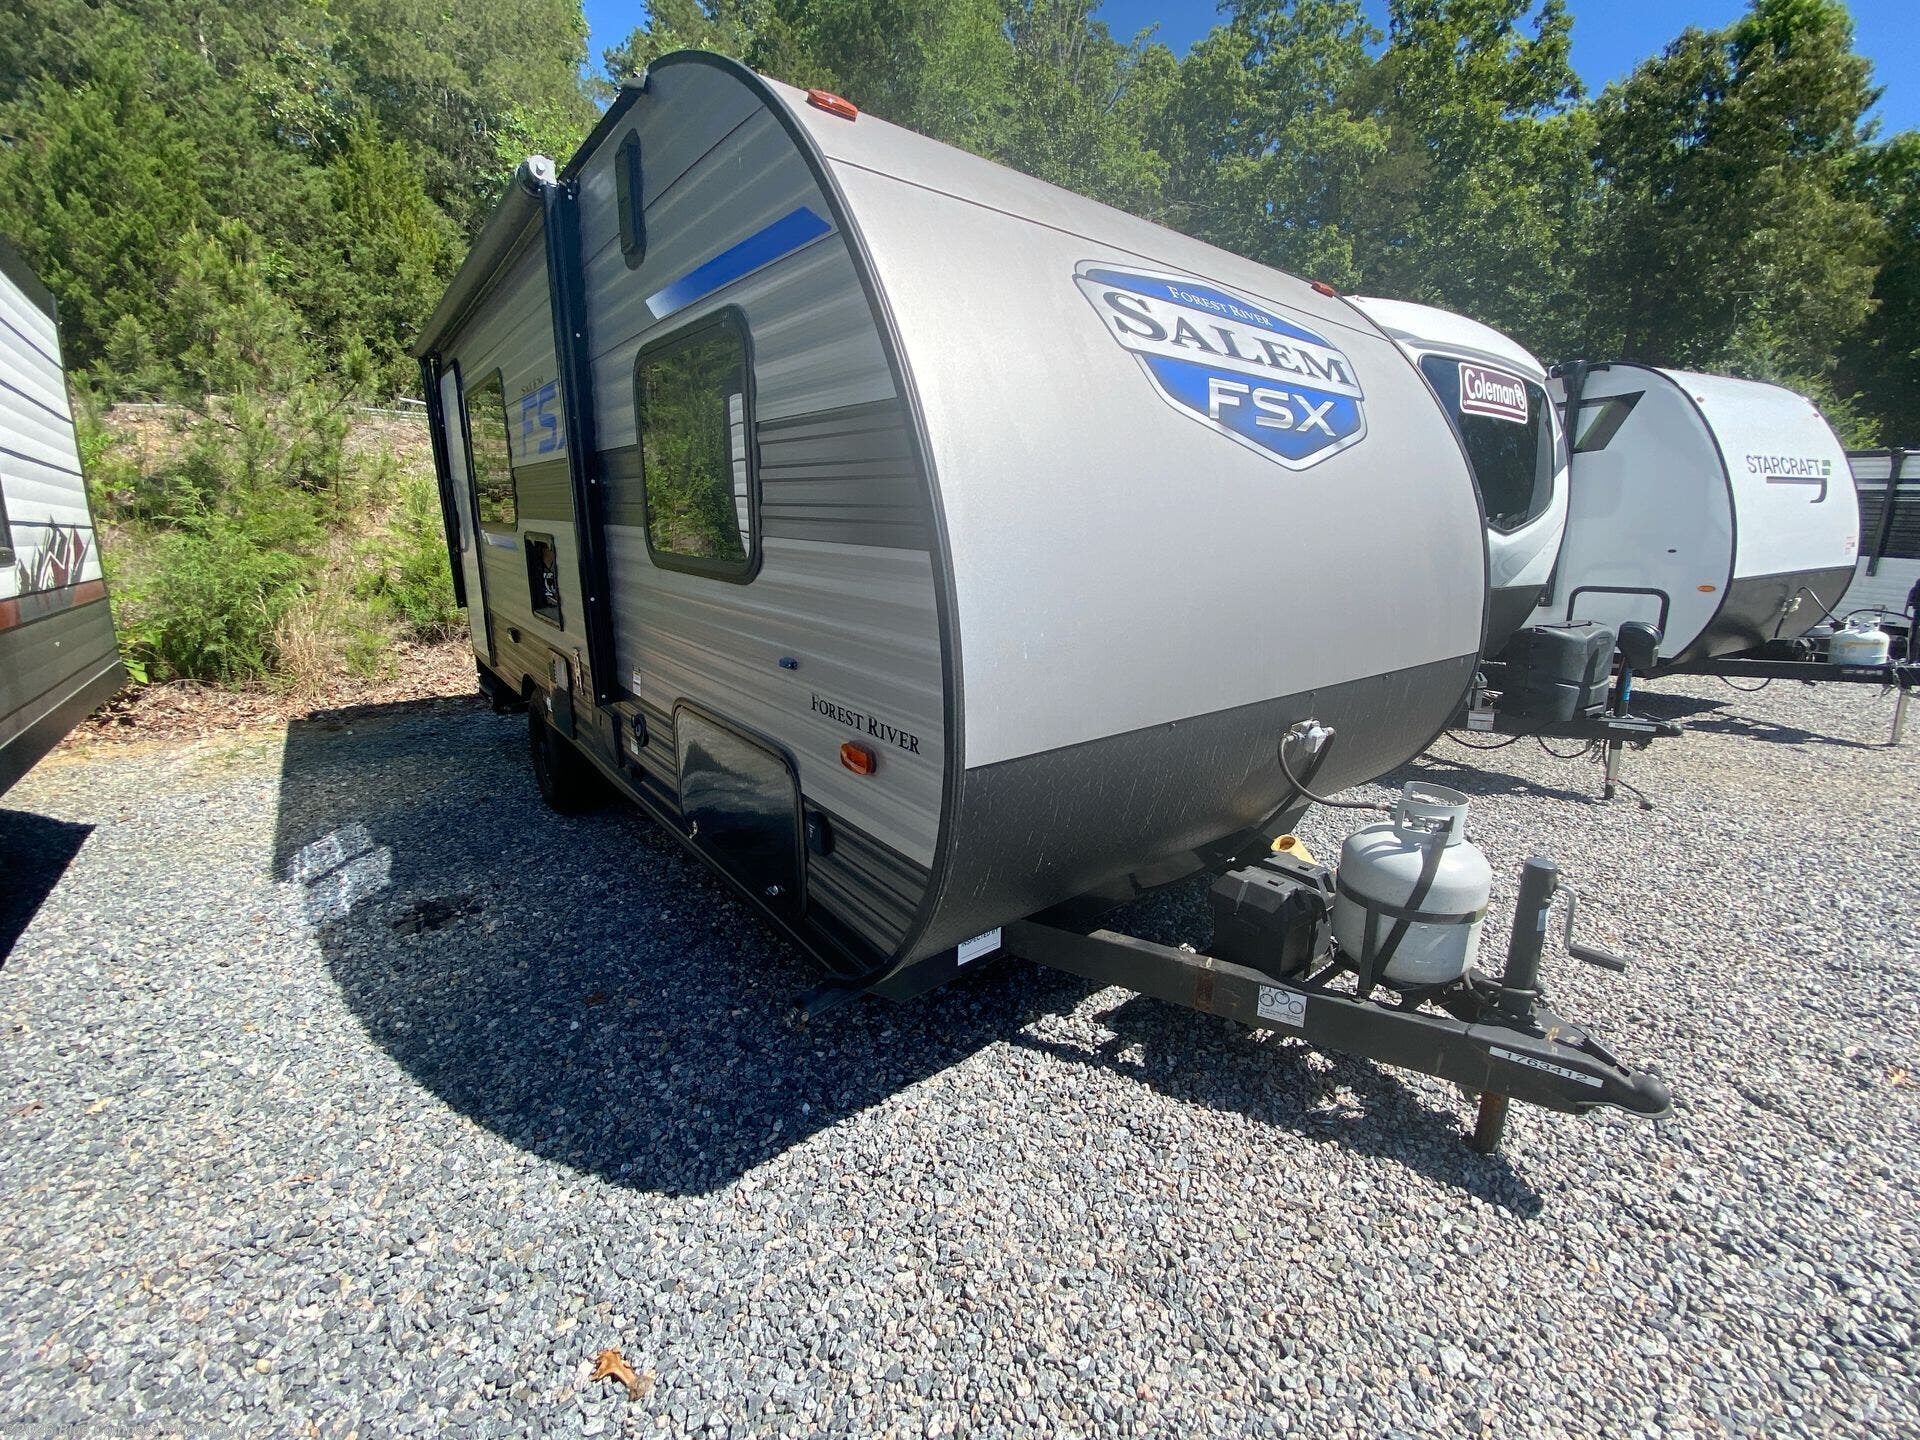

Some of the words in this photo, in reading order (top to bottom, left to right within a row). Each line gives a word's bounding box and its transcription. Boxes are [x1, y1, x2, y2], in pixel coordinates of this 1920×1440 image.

[1166, 285, 1228, 313] FOREST
[1228, 304, 1273, 327] RIVER
[1102, 291, 1356, 387] SALEM
[1208, 377, 1337, 437] FSX
[1464, 368, 1517, 407] Coleman
[1745, 454, 1820, 476] STARCRAFT
[810, 692, 865, 730] FOREST
[866, 714, 921, 755] RIVER
[1505, 1052, 1589, 1083] 1763412
